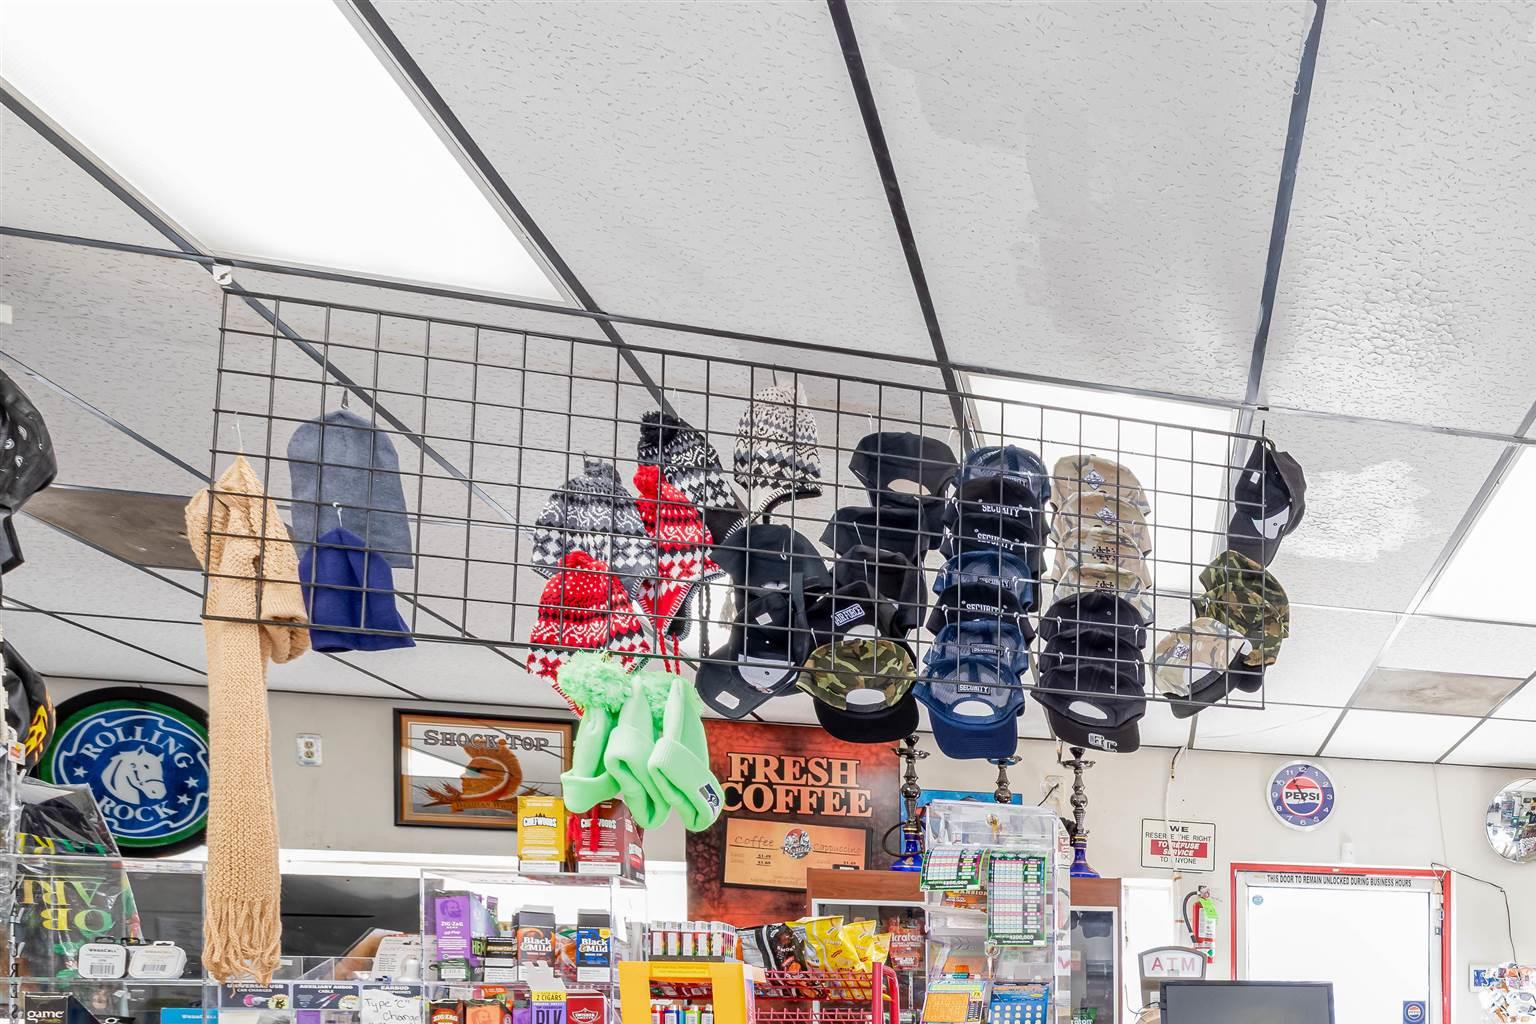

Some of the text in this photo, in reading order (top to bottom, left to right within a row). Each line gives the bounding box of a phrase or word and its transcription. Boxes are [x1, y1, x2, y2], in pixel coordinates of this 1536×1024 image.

[959, 684, 992, 694] SECURITY
[423, 729, 549, 751] SHOCK TOP
[80, 726, 194, 769] ROLLING
[727, 752, 861, 788] FRESH
[720, 781, 873, 818] COFFEE
[1285, 791, 1320, 801] PEPSI
[99, 795, 179, 823] ROCK
[1145, 832, 1175, 840] RESERE
[1162, 848, 1195, 857] SRVICE
[1267, 874, 1412, 888] THIS DOOR TO REMAIN UNLOCKED DURING BUSINESS HOURS
[523, 936, 551, 945] Black
[582, 937, 608, 946] Black
[1151, 956, 1195, 972] ATM
[27, 1009, 65, 1024] game
